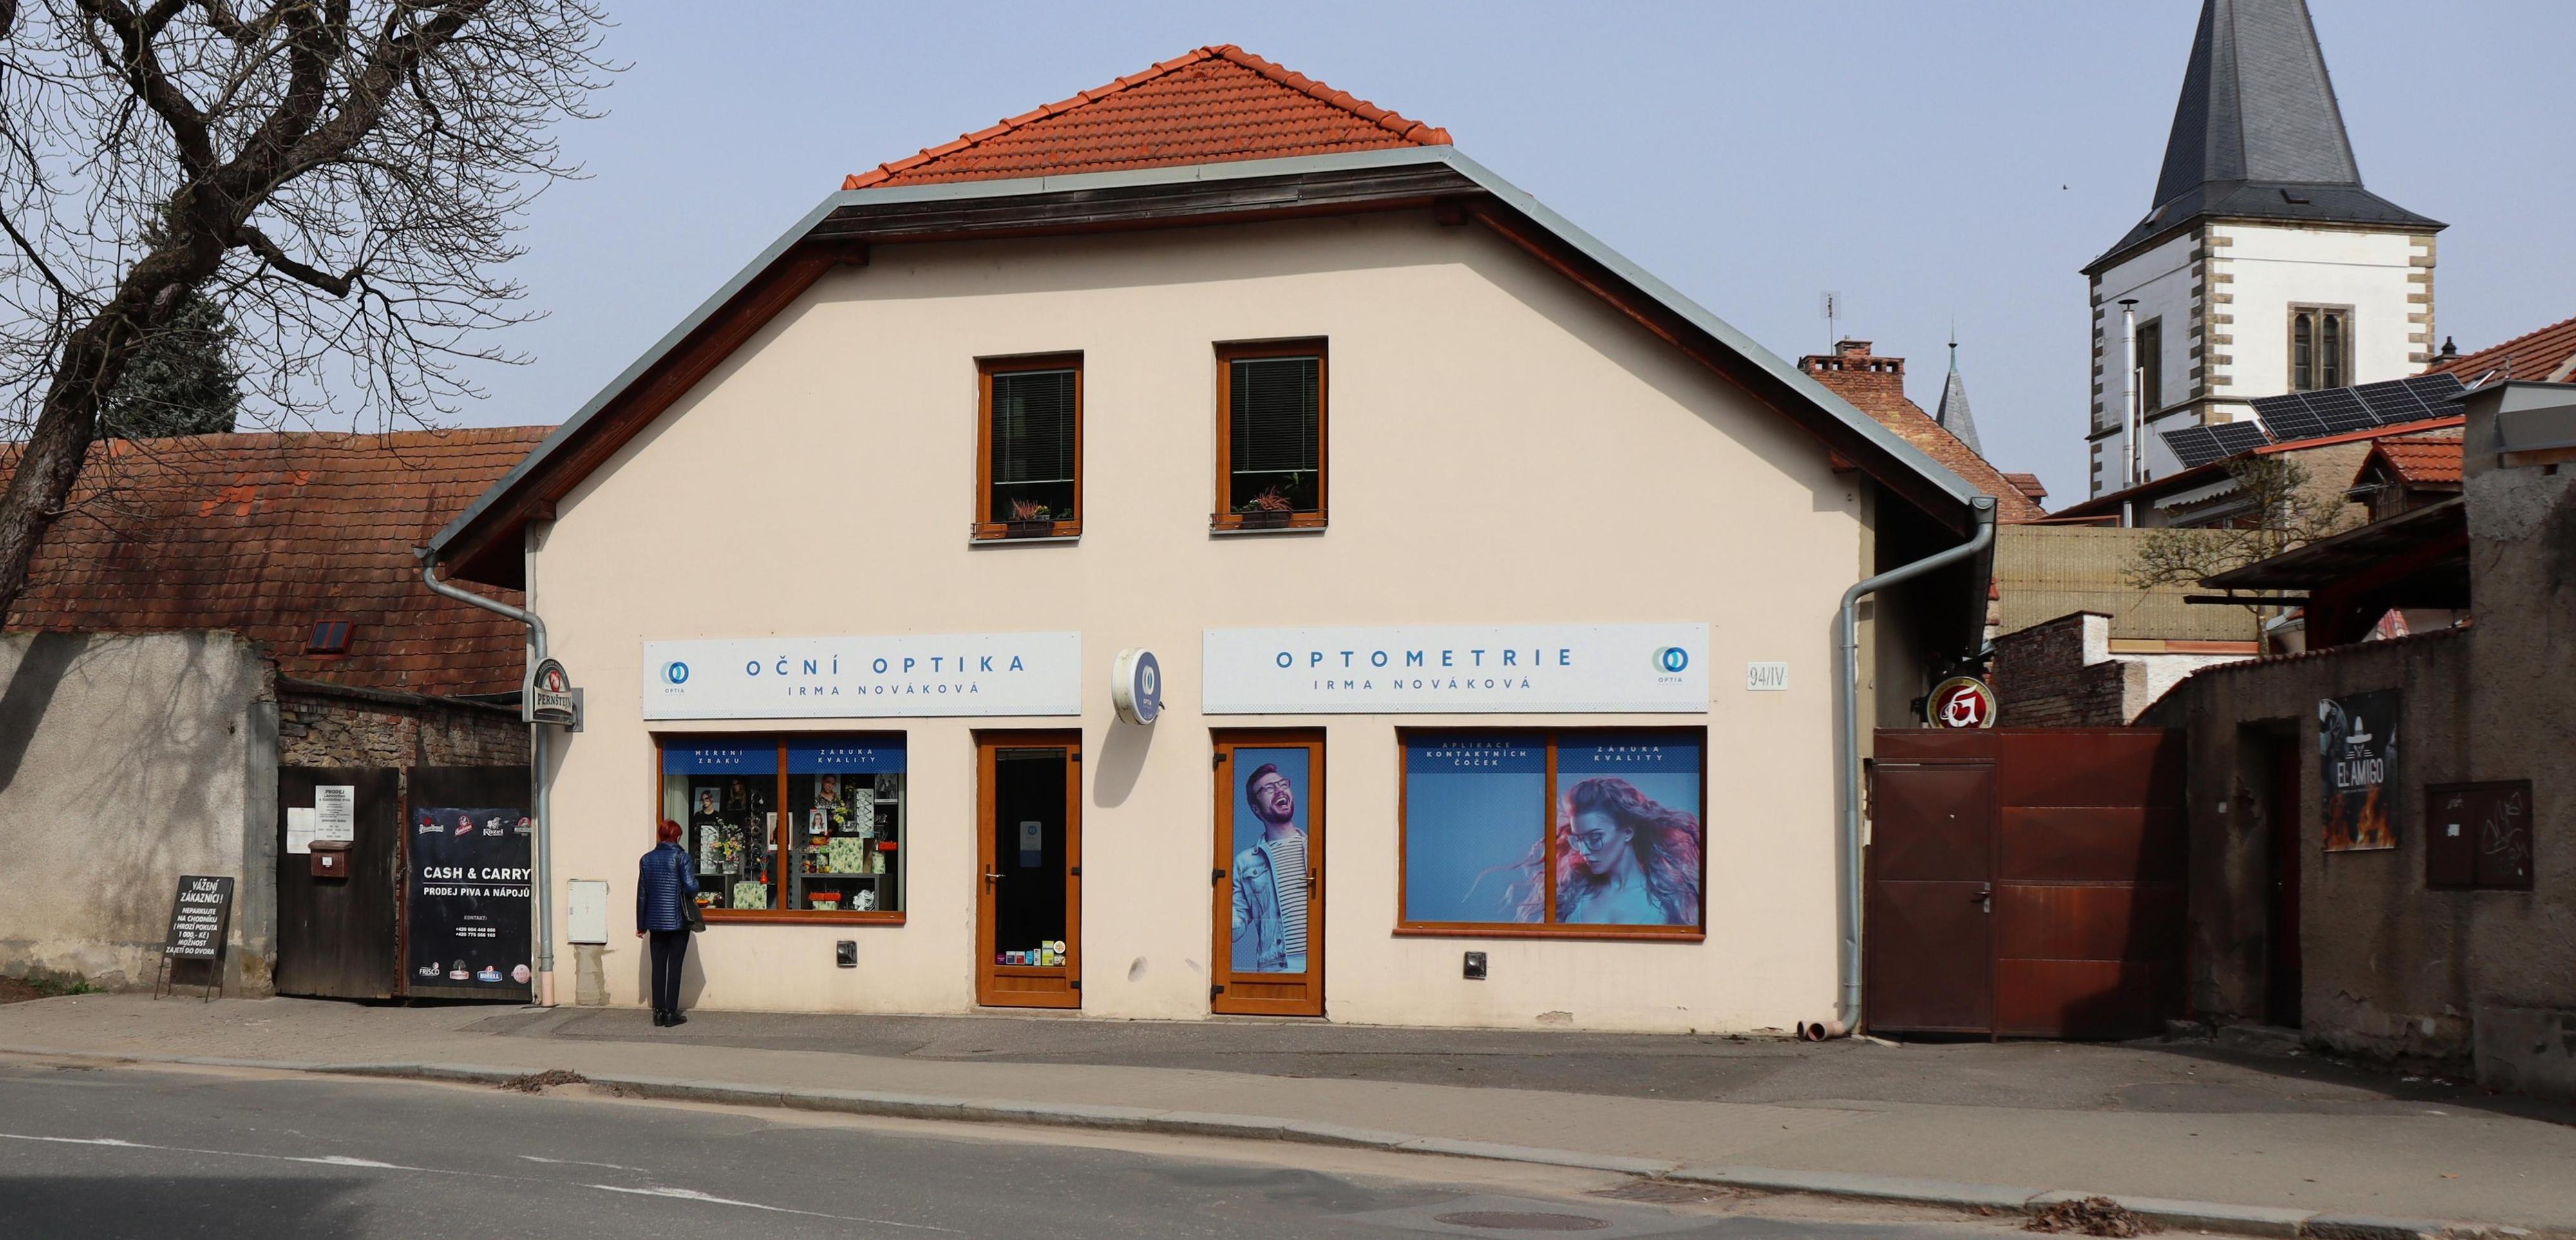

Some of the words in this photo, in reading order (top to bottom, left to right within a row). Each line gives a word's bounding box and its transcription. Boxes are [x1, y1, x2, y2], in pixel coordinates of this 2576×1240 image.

[746, 654, 838, 676] OČNÍ
[873, 655, 1025, 674] OPTIKA
[1276, 649, 1571, 668] OPTOMETRIE
[1314, 680, 1372, 690] IRMA
[1394, 676, 1531, 690] NOVÁKOVÁ
[1750, 666, 1785, 686] 94/IV
[788, 686, 840, 696] IRMA
[858, 682, 980, 696] NOVÁKOVÁ
[1426, 749, 1526, 758] KONTAKTNÍCH
[2337, 761, 2350, 787] EL
[2351, 758, 2384, 786] AMIGO
[423, 866, 463, 879] CASH
[468, 867, 477, 879] &
[482, 868, 531, 881] CARRY
[193, 878, 220, 892] VÁŽENÍ
[424, 887, 458, 897] PRODEJ
[460, 888, 481, 897] PIVA
[484, 888, 491, 897] A
[493, 886, 530, 898] NÁPOJŮ
[187, 914, 218, 923] CHODNÍKU
[178, 937, 207, 947] MOŽNOST
[166, 945, 185, 955] ZAJETÍ
